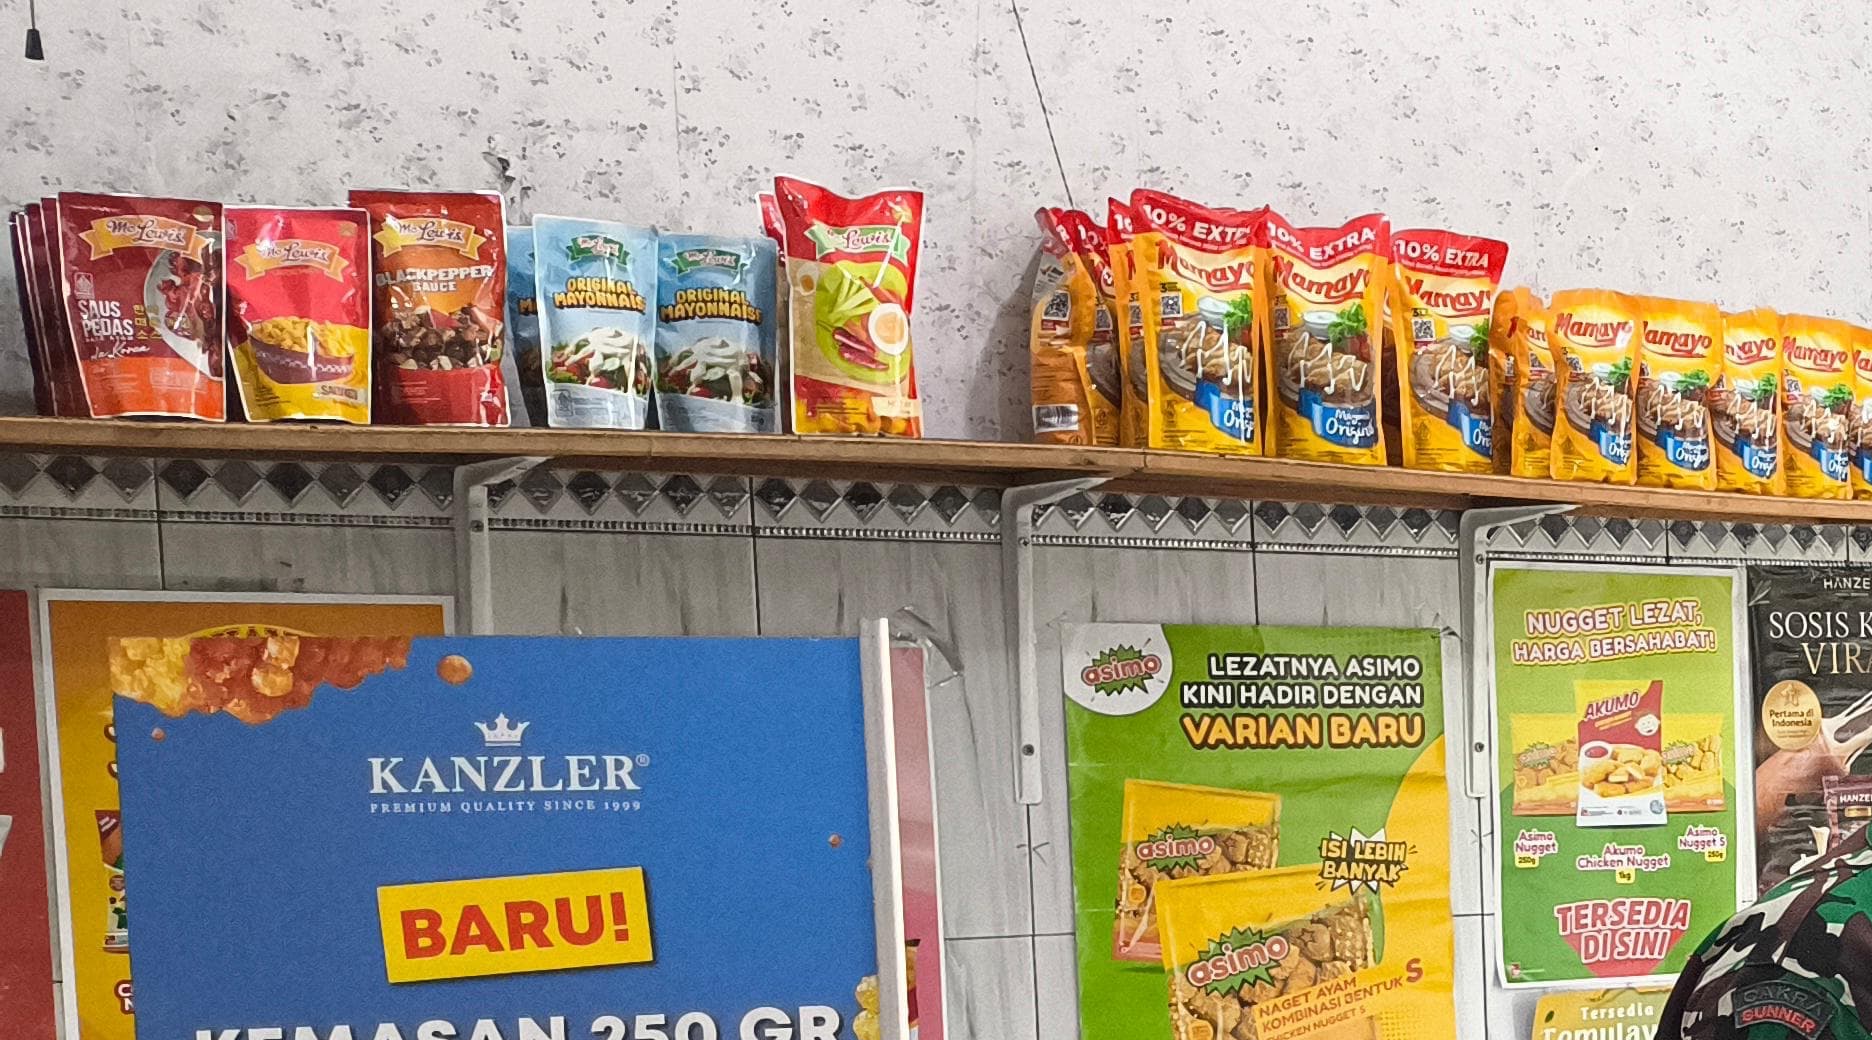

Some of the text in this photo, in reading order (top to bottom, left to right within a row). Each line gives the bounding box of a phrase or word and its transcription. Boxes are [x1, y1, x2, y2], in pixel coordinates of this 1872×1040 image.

[136, 216, 186, 244] Lewis
[1143, 204, 1186, 232] 10%
[417, 220, 464, 242] Lewis
[1267, 221, 1304, 253] 10%
[1309, 227, 1377, 261] EXTRA
[1394, 239, 1489, 268] 10% EXTRA
[376, 265, 493, 287] BLACKPEPPER
[413, 281, 457, 292] SAUCE
[566, 277, 636, 295] ORIGINAL
[554, 291, 646, 315] MAYONNAIS
[676, 288, 750, 306] ORIGINAL
[1404, 275, 1491, 313] Mamay
[78, 300, 121, 318] SAUS
[82, 318, 134, 338] PEDAS
[1782, 336, 1849, 371] Mamayo
[1526, 600, 1703, 635] NUGGET LEZAT,
[1768, 611, 1850, 639] SOSIS
[1513, 629, 1717, 664] HARGA BERSAHABAT!
[1080, 652, 1163, 688] asimo
[1209, 655, 1421, 679] LEZATNYA ASIMO
[1181, 683, 1422, 707] KINI HADIR DENGAN
[1583, 690, 1641, 721] AKUMO
[1769, 709, 1804, 720] Pertama
[1771, 718, 1813, 728] Indonesia
[1182, 714, 1425, 747] VARIAN BARU
[369, 799, 642, 814] PREMIUM QUALITY SINCE 1999
[1518, 831, 1554, 842] Asimo
[1686, 825, 1719, 836] Asimo
[1135, 832, 1216, 860] asimo
[1320, 838, 1408, 862] ISI LEBIH
[1515, 842, 1558, 856] Nugget
[1603, 844, 1644, 856] Akumo
[1679, 837, 1717, 850] Nugget
[1322, 860, 1402, 882] BANYAK
[1577, 855, 1669, 870] Chicken Nugget
[399, 891, 631, 960] BARU!
[1556, 900, 1690, 934] TERSEDIA
[1186, 933, 1289, 988] asimo
[1258, 976, 1357, 1019] NAGET AYAM
[1262, 957, 1424, 1034] KOMBINASI BENTUK S
[1313, 1007, 1357, 1031] NUGGET
[1580, 1002, 1655, 1021] Tersedia
